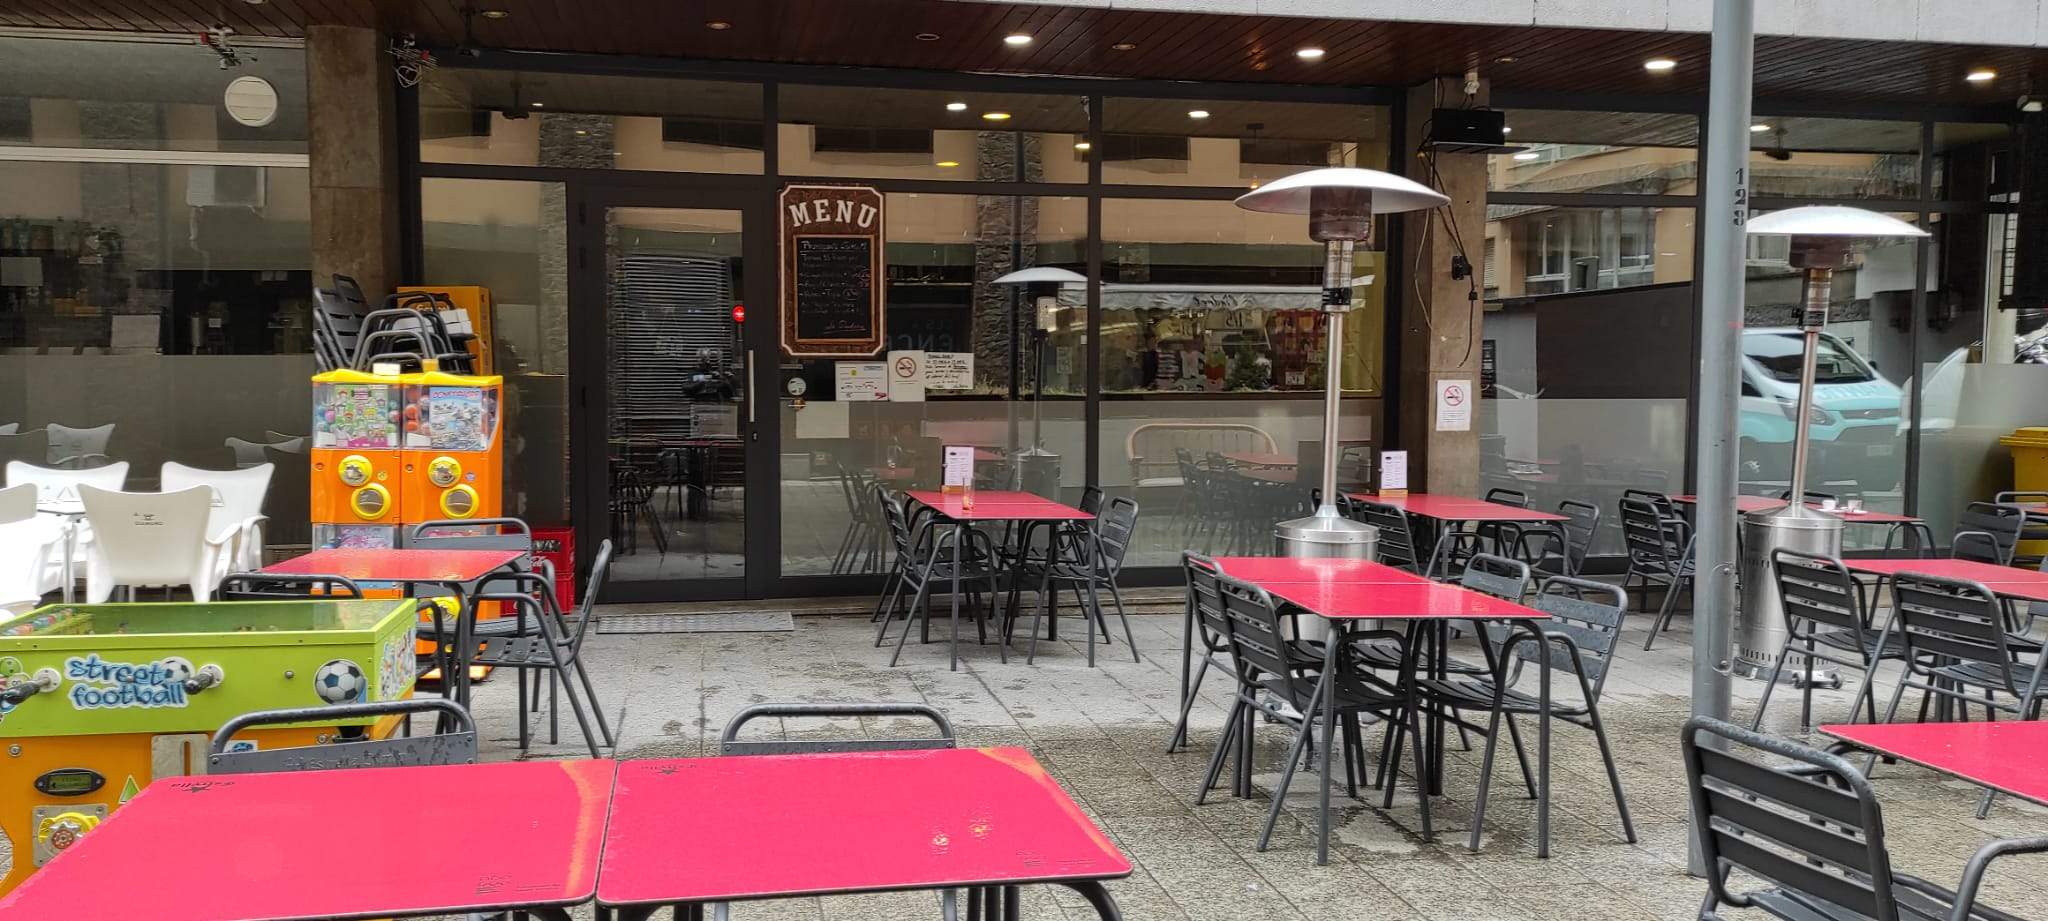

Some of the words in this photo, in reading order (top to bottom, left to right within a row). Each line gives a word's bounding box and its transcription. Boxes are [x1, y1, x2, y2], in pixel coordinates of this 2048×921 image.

[1733, 168, 1746, 226] 128
[788, 199, 877, 229] MENU
[70, 655, 163, 685] street
[72, 684, 185, 706] football
